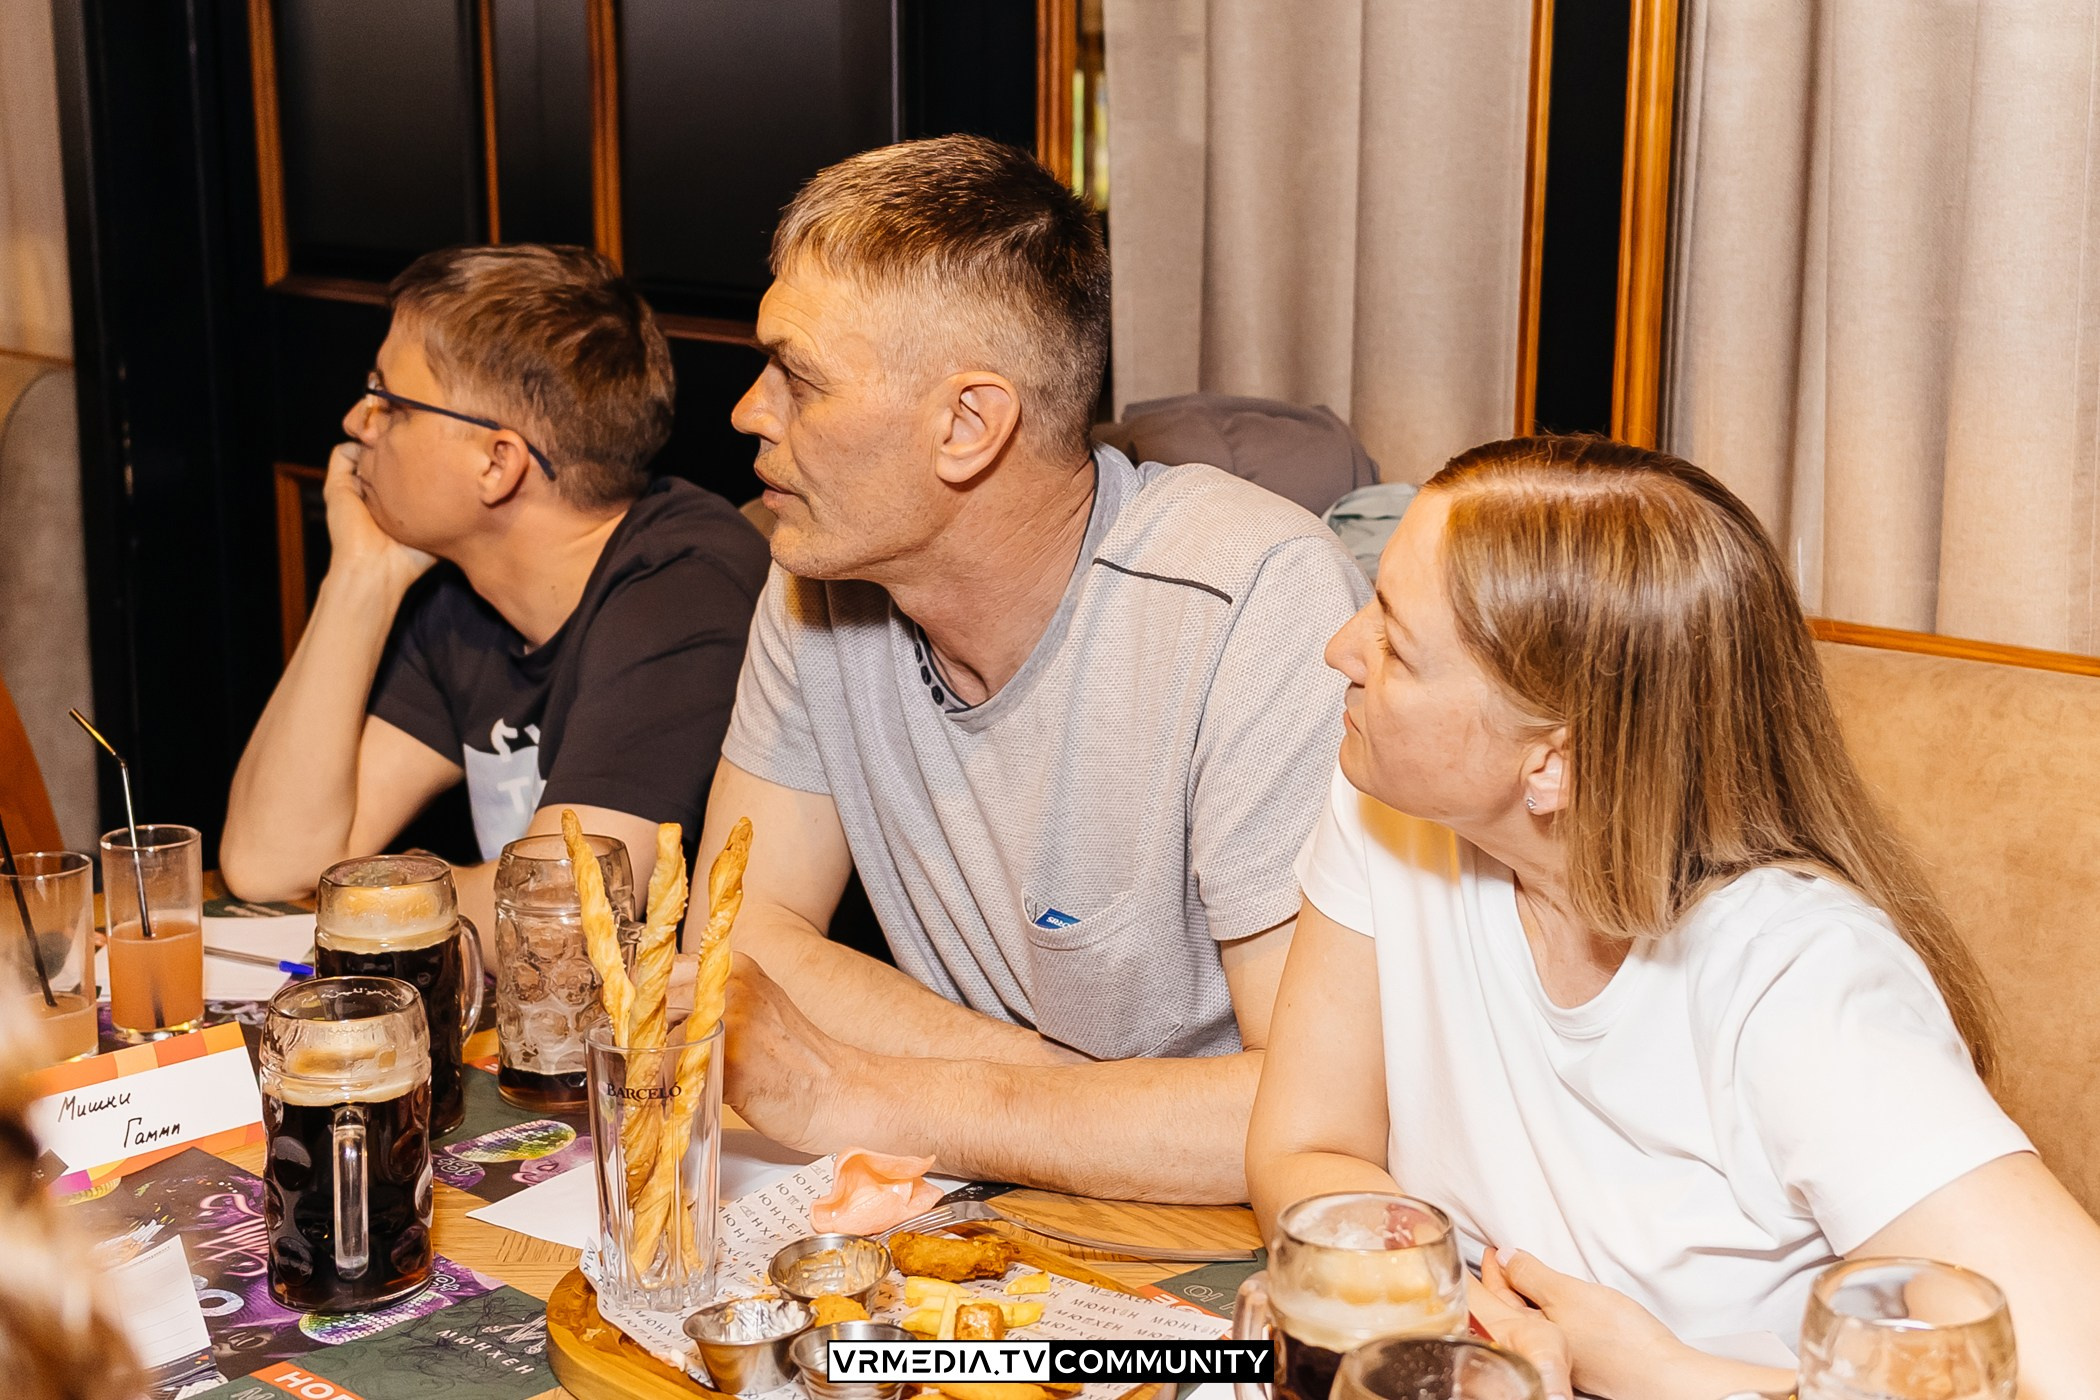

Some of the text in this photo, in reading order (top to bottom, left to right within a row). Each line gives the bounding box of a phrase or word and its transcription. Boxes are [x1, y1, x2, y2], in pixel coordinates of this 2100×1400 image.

[57, 1092, 131, 1122] Мишки
[606, 1082, 682, 1102] BARCELÓ
[435, 1329, 535, 1375] МЮНХЕН
